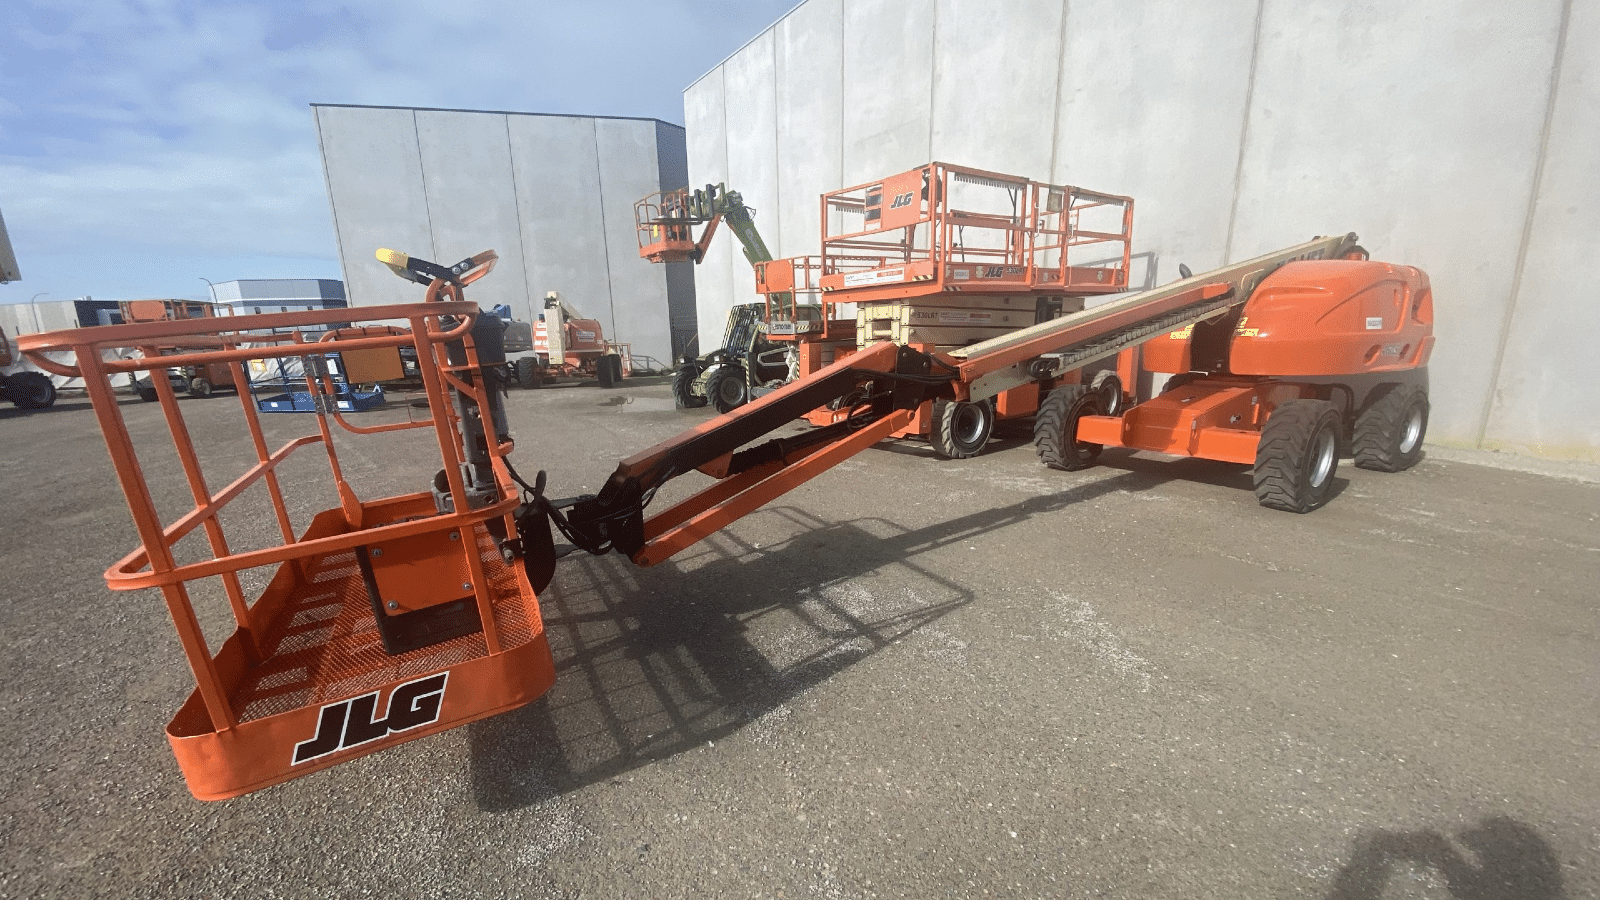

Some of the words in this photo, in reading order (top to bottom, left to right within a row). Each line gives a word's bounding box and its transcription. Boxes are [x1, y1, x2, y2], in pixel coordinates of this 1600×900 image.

[890, 192, 914, 209] JLG
[984, 266, 1004, 279] JLG
[291, 671, 449, 766] JLG
